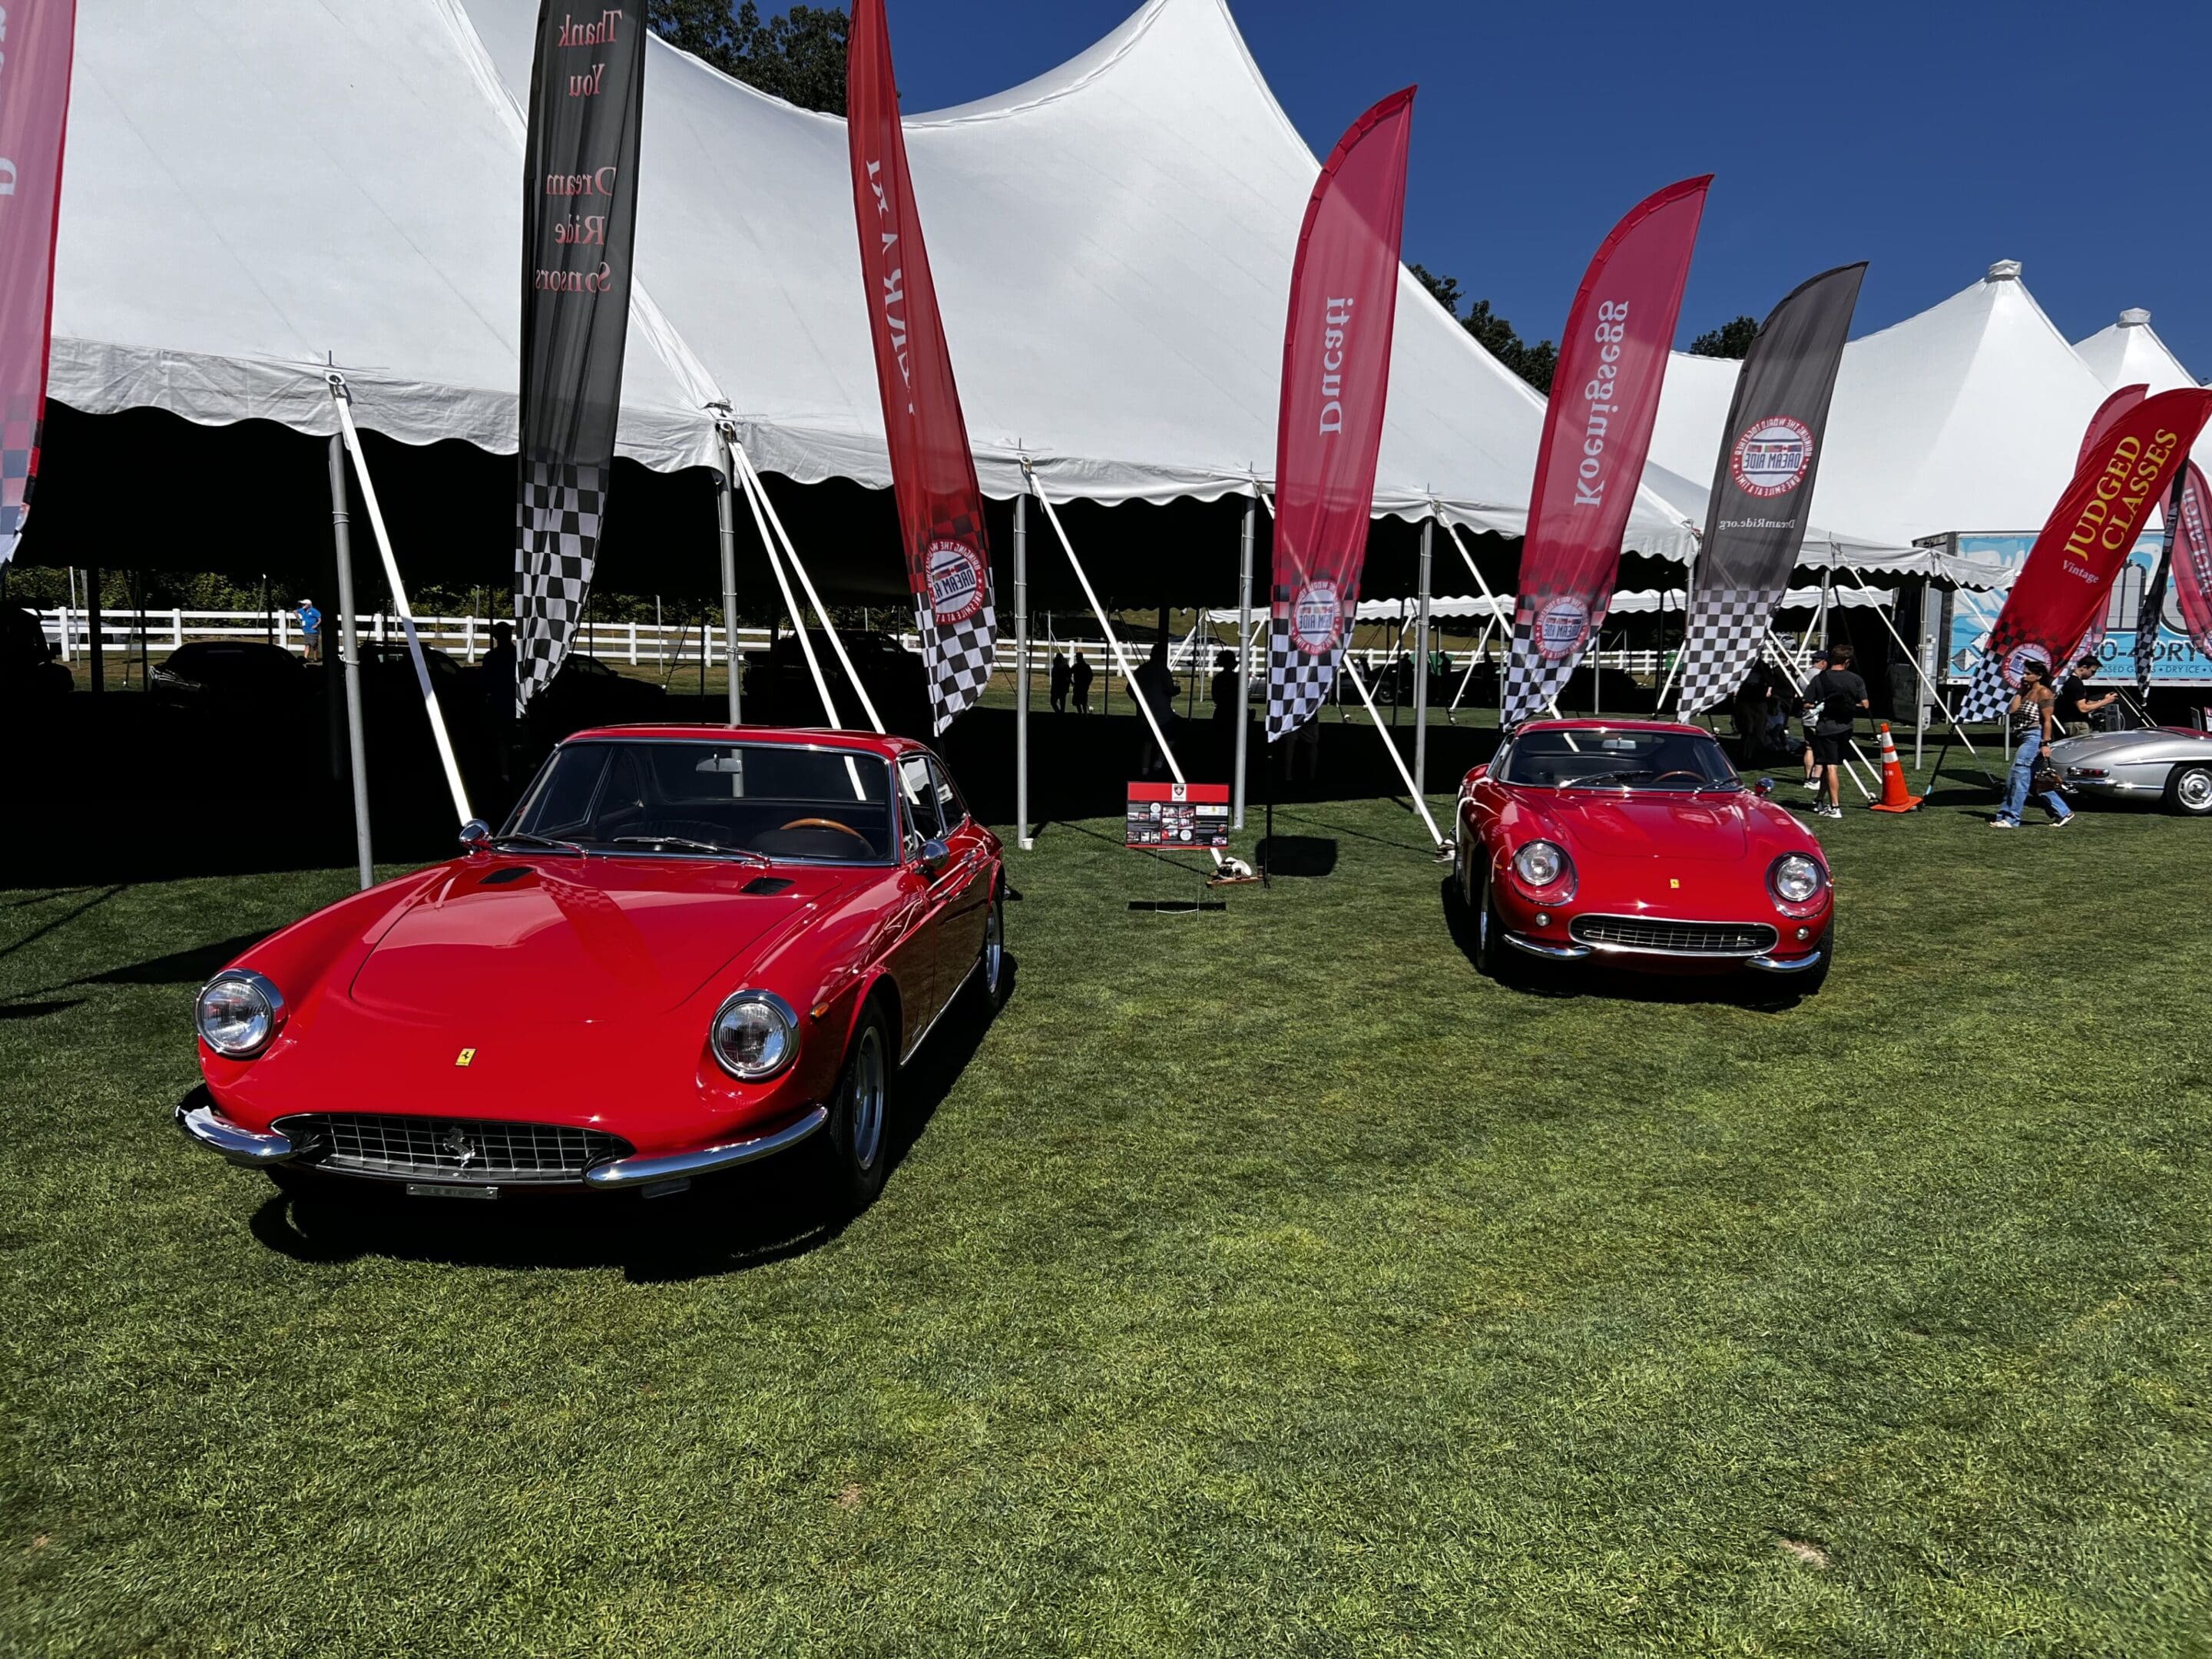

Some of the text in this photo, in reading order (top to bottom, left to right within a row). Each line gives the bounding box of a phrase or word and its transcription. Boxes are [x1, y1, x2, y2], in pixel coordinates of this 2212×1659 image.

[2063, 435, 2141, 561] JUDGED
[2101, 429, 2178, 550] CLASSES
[2062, 559, 2099, 584] Vintage
